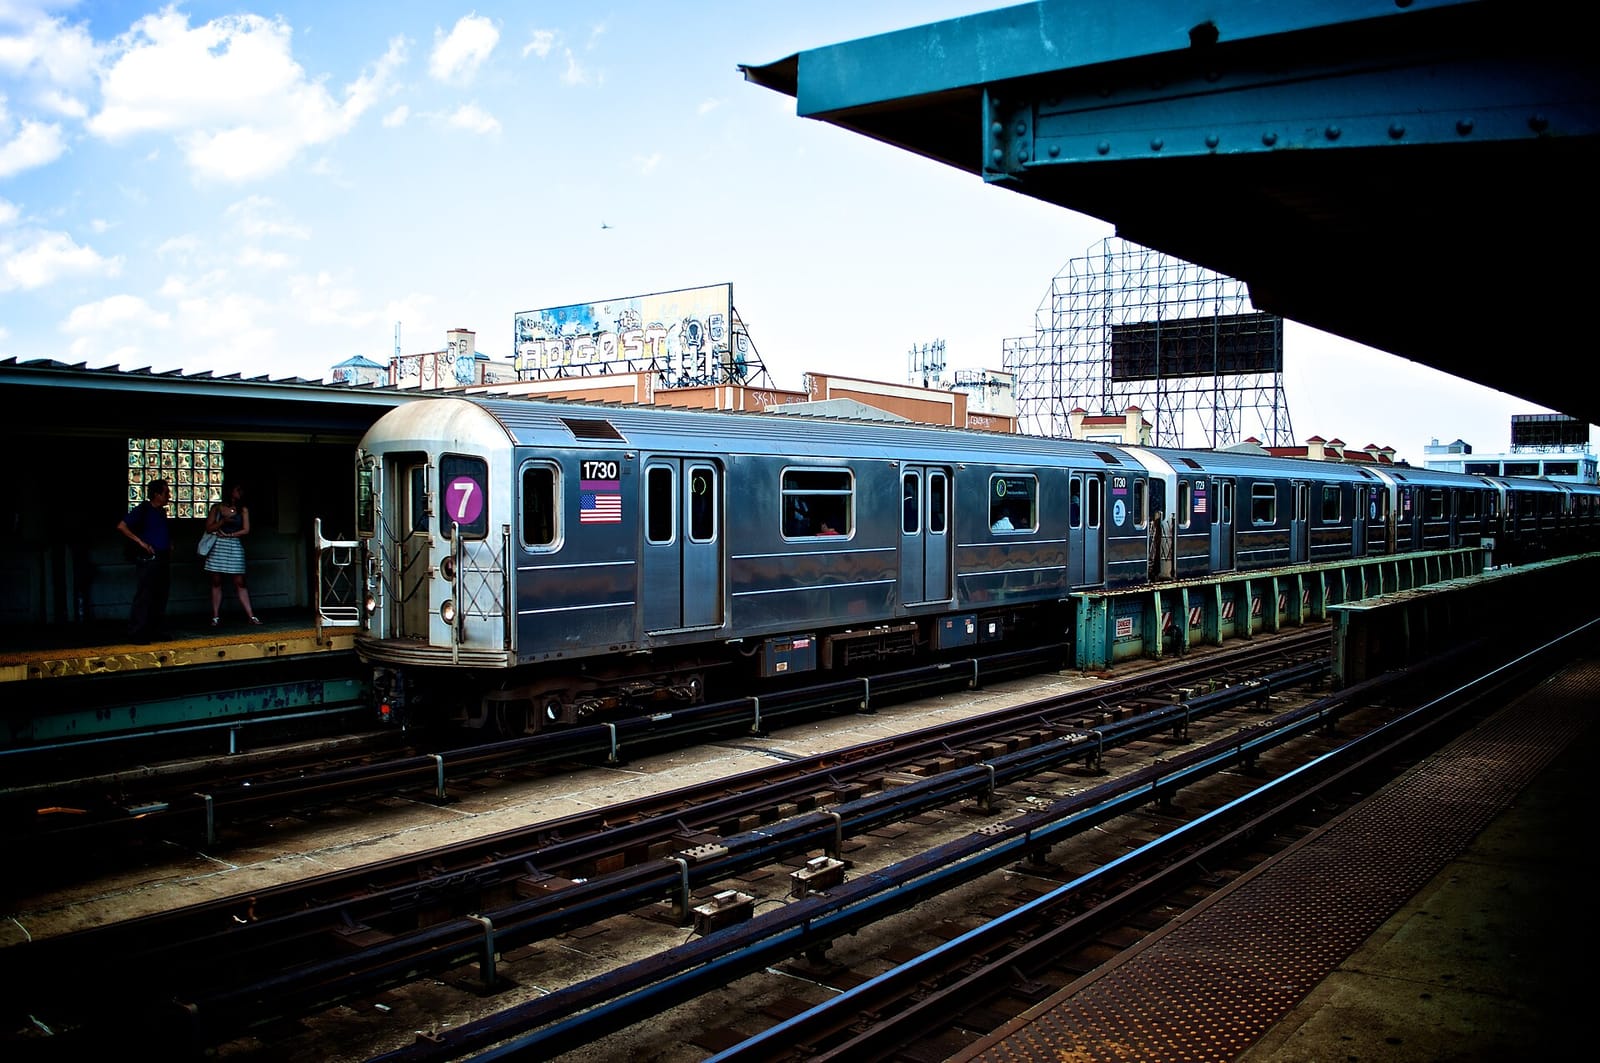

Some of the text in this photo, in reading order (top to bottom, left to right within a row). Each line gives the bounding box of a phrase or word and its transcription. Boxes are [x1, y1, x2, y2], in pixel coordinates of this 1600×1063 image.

[583, 461, 617, 479] 1730
[1113, 477, 1126, 488] 1730
[454, 483, 474, 518] 7
